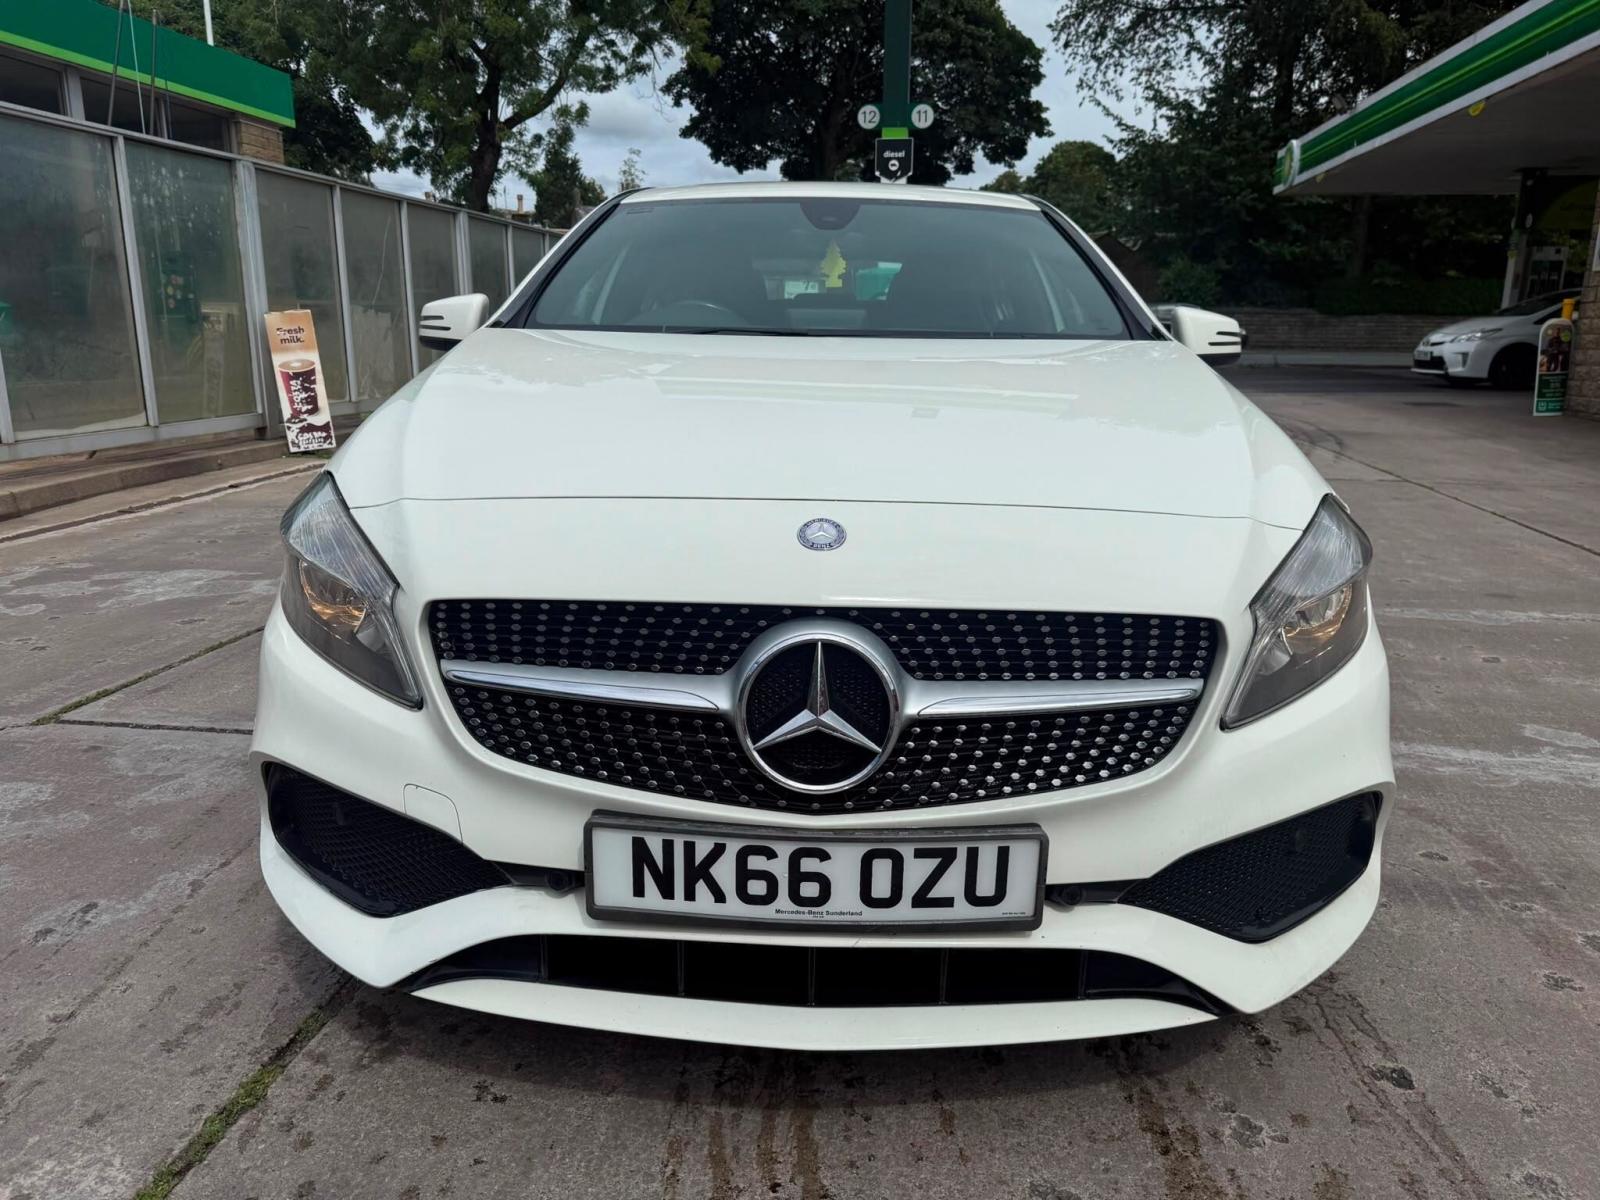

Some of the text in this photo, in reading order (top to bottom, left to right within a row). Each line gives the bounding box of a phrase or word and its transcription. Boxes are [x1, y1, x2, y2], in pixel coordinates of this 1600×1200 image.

[861, 111, 877, 123] 12
[916, 110, 928, 123] 11
[883, 150, 905, 158] diesel
[276, 325, 304, 336] Fresh
[632, 837, 1010, 909] NK66 OZU
